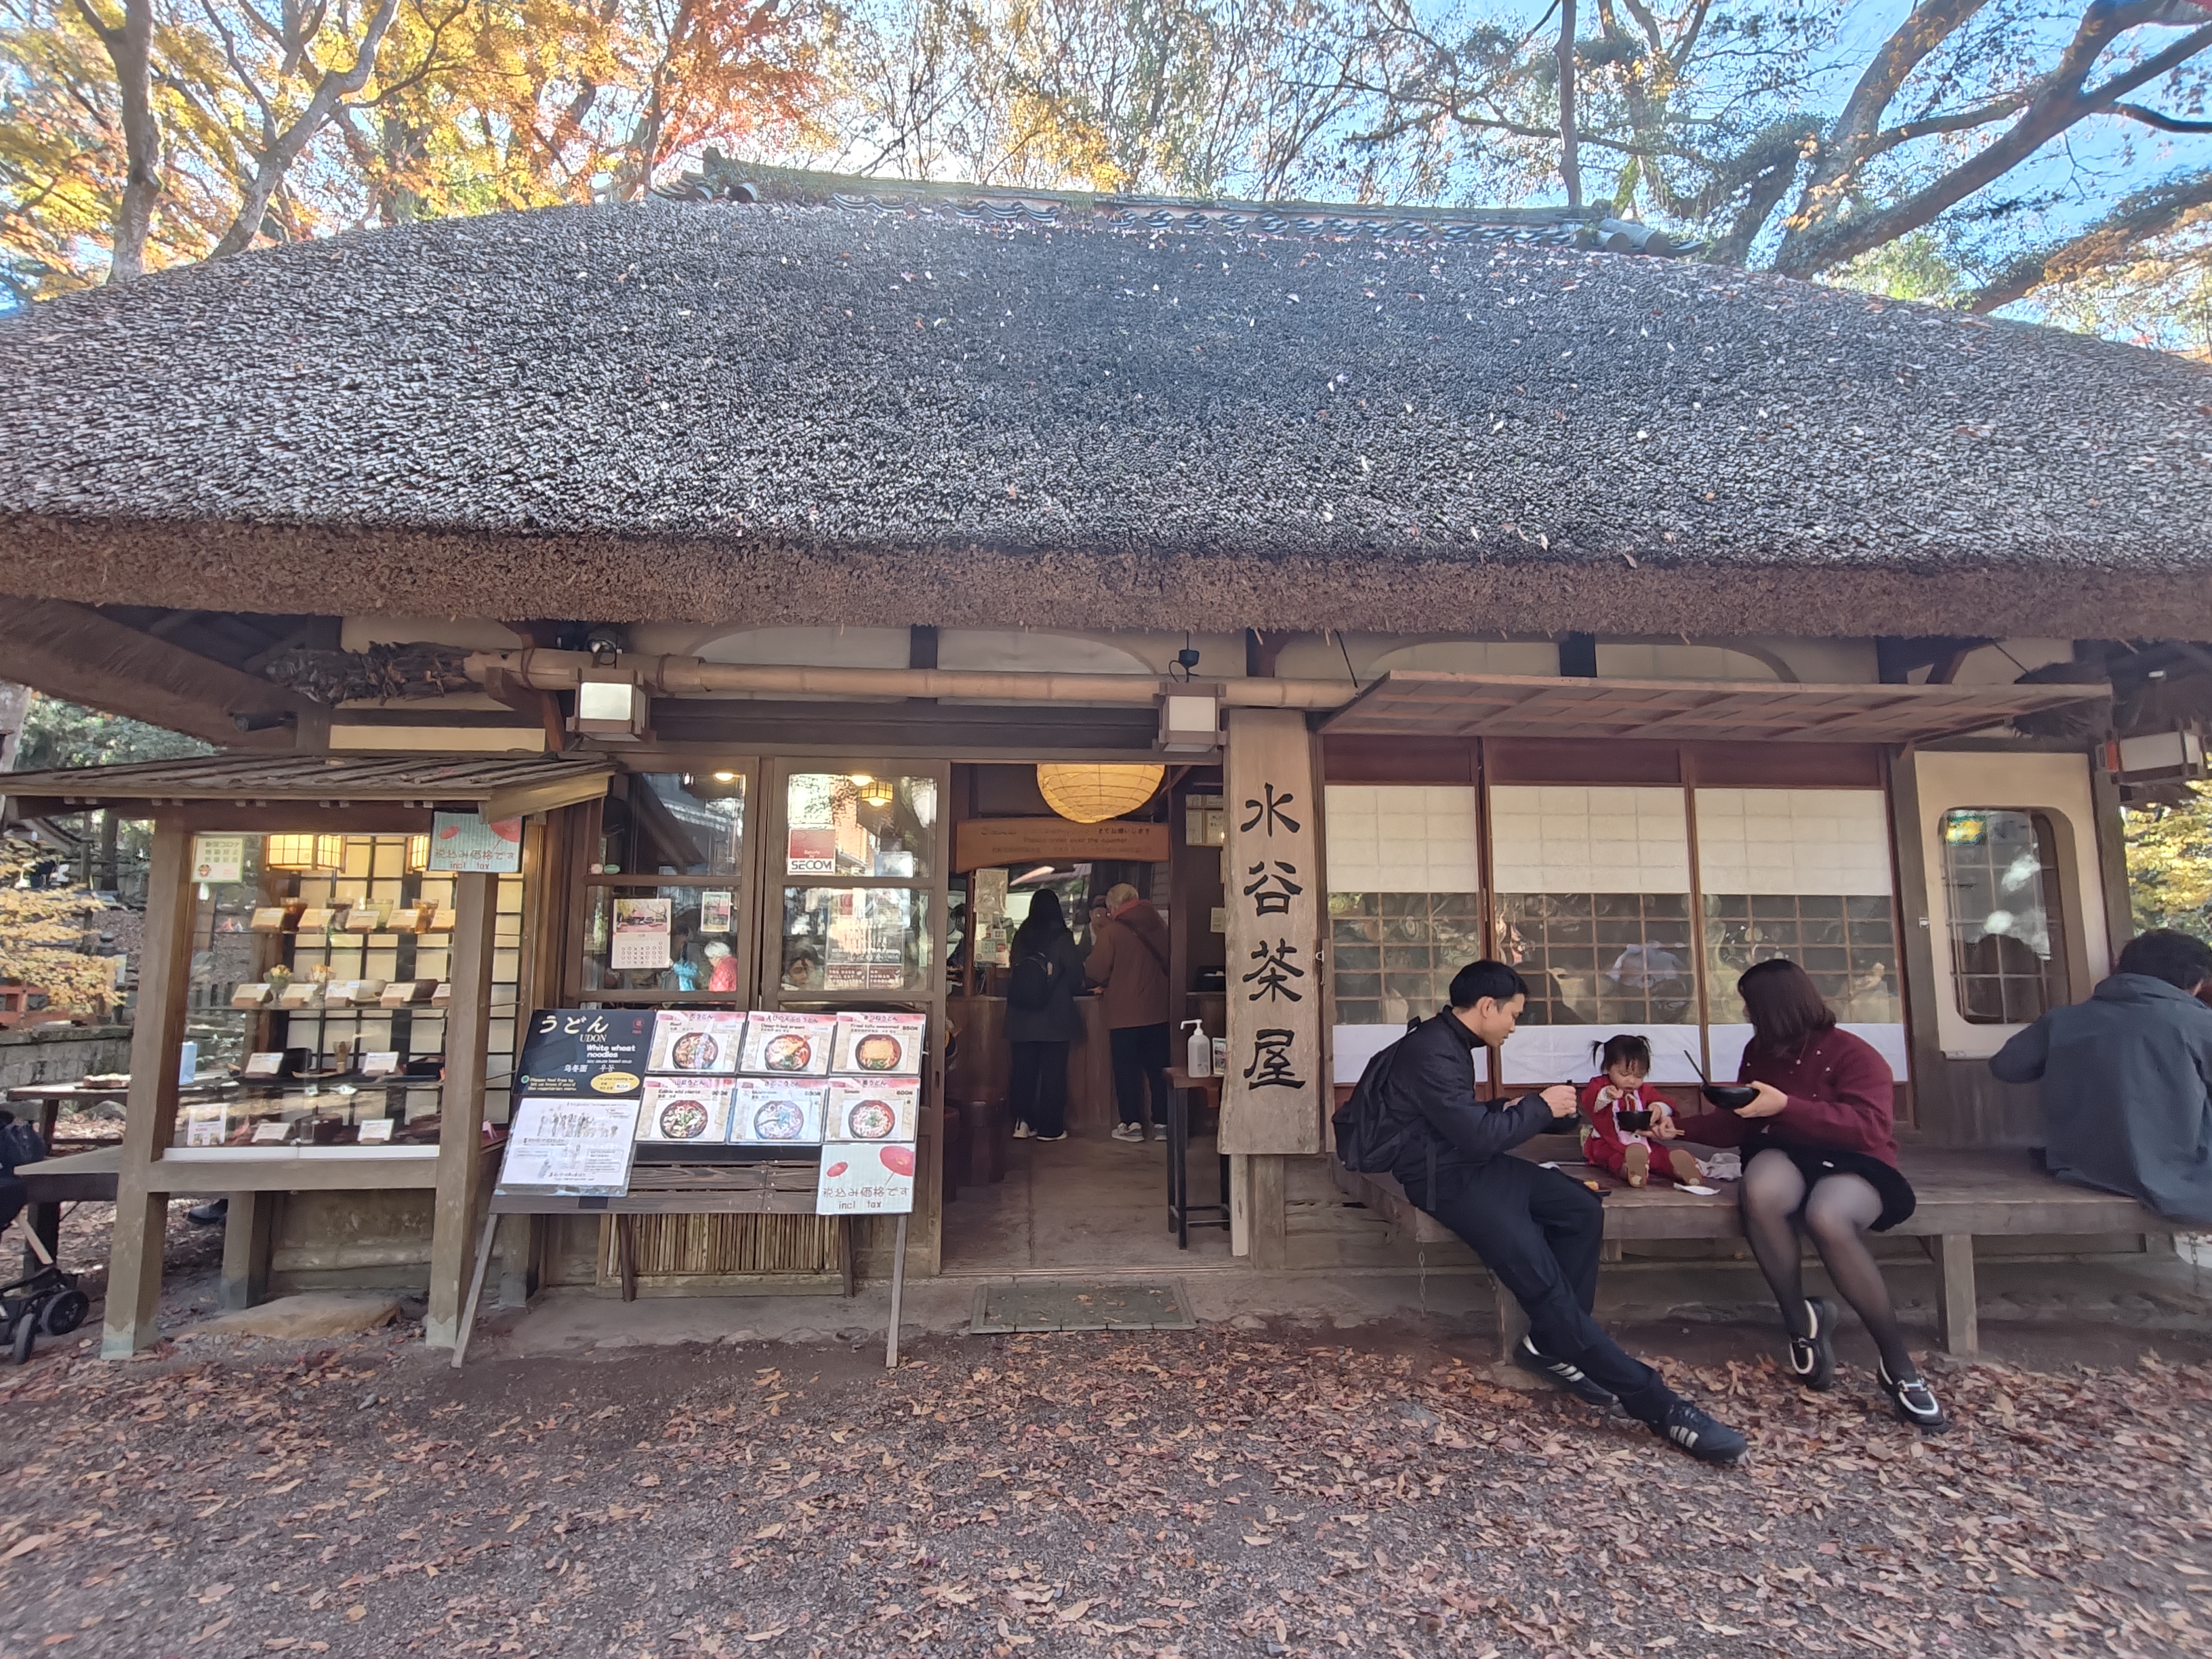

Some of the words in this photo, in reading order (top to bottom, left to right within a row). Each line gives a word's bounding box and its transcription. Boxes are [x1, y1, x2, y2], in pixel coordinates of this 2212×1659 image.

[435, 848, 515, 861] 税込み価格です
[476, 862, 490, 870] tax
[791, 860, 832, 870] SECOM
[1241, 782, 1305, 1090] 水谷茶屋
[539, 1015, 609, 1035] うどん
[579, 1033, 608, 1043] UDON
[611, 1044, 636, 1052] wheat
[822, 1186, 909, 1197] 税込み価格です
[838, 1200, 856, 1210] incl
[867, 1200, 882, 1208] tax
